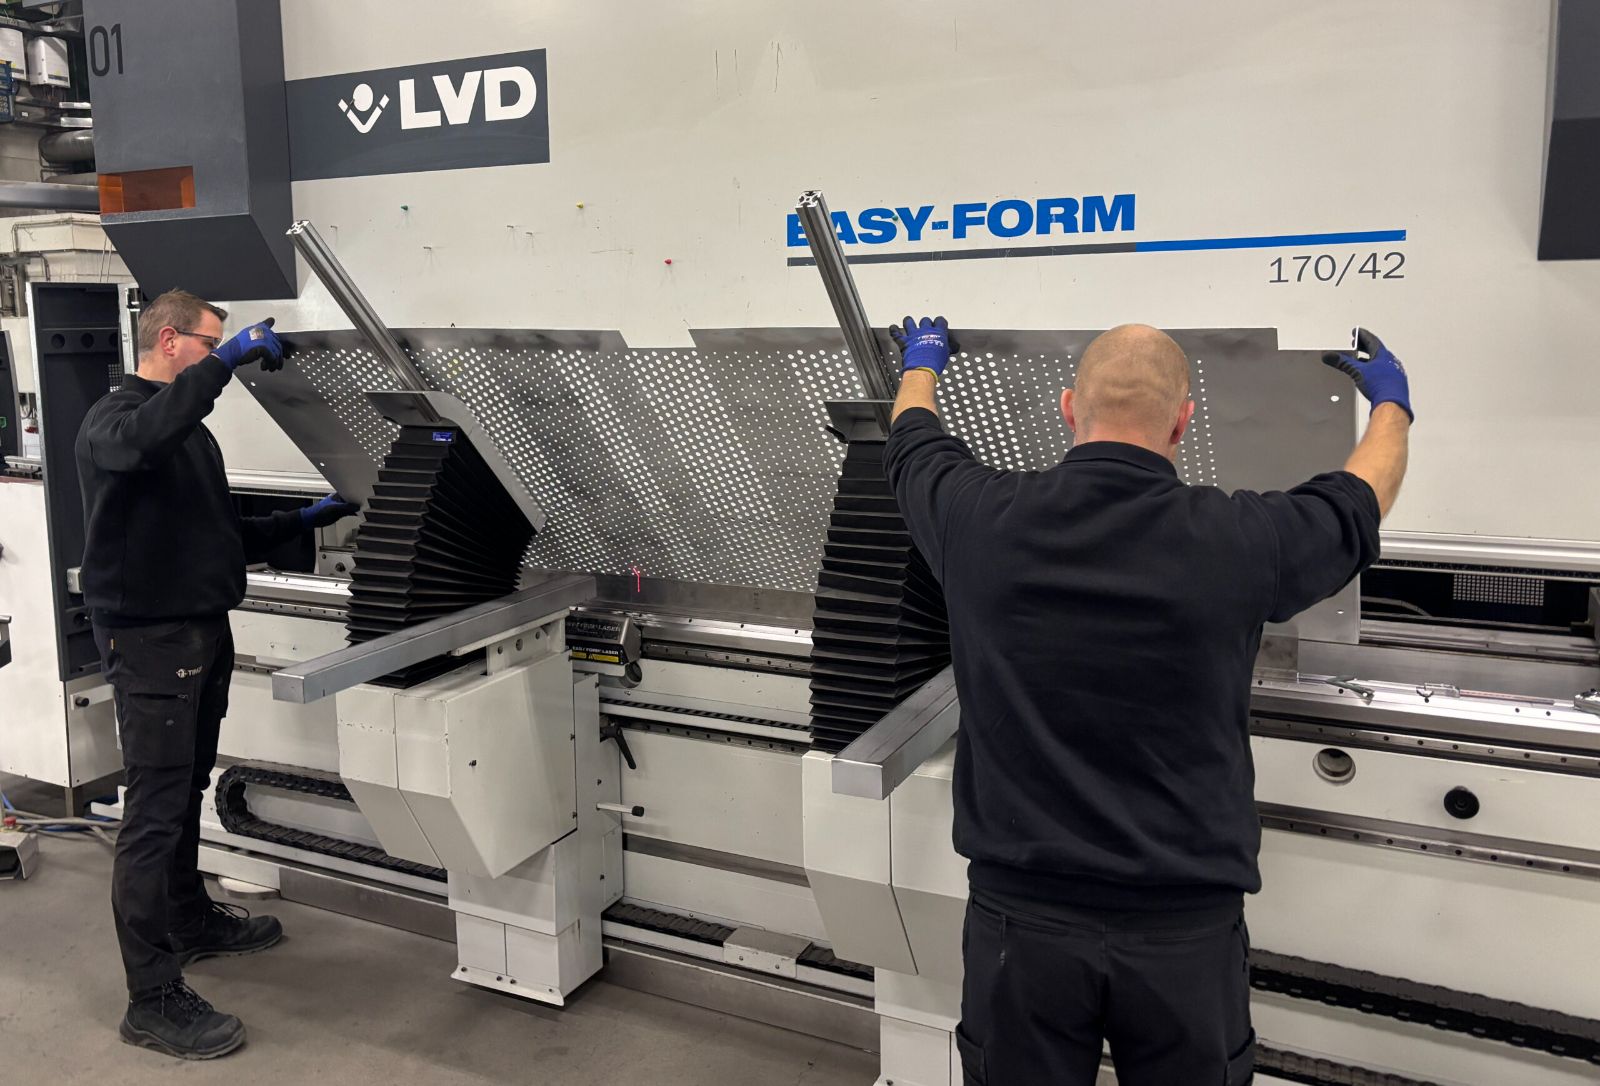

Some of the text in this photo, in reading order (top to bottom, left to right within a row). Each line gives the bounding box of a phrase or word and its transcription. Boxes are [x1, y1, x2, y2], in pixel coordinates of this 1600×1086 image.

[90, 23, 124, 77] 01
[398, 65, 538, 131] LVD
[1268, 251, 1406, 287] 170/42
